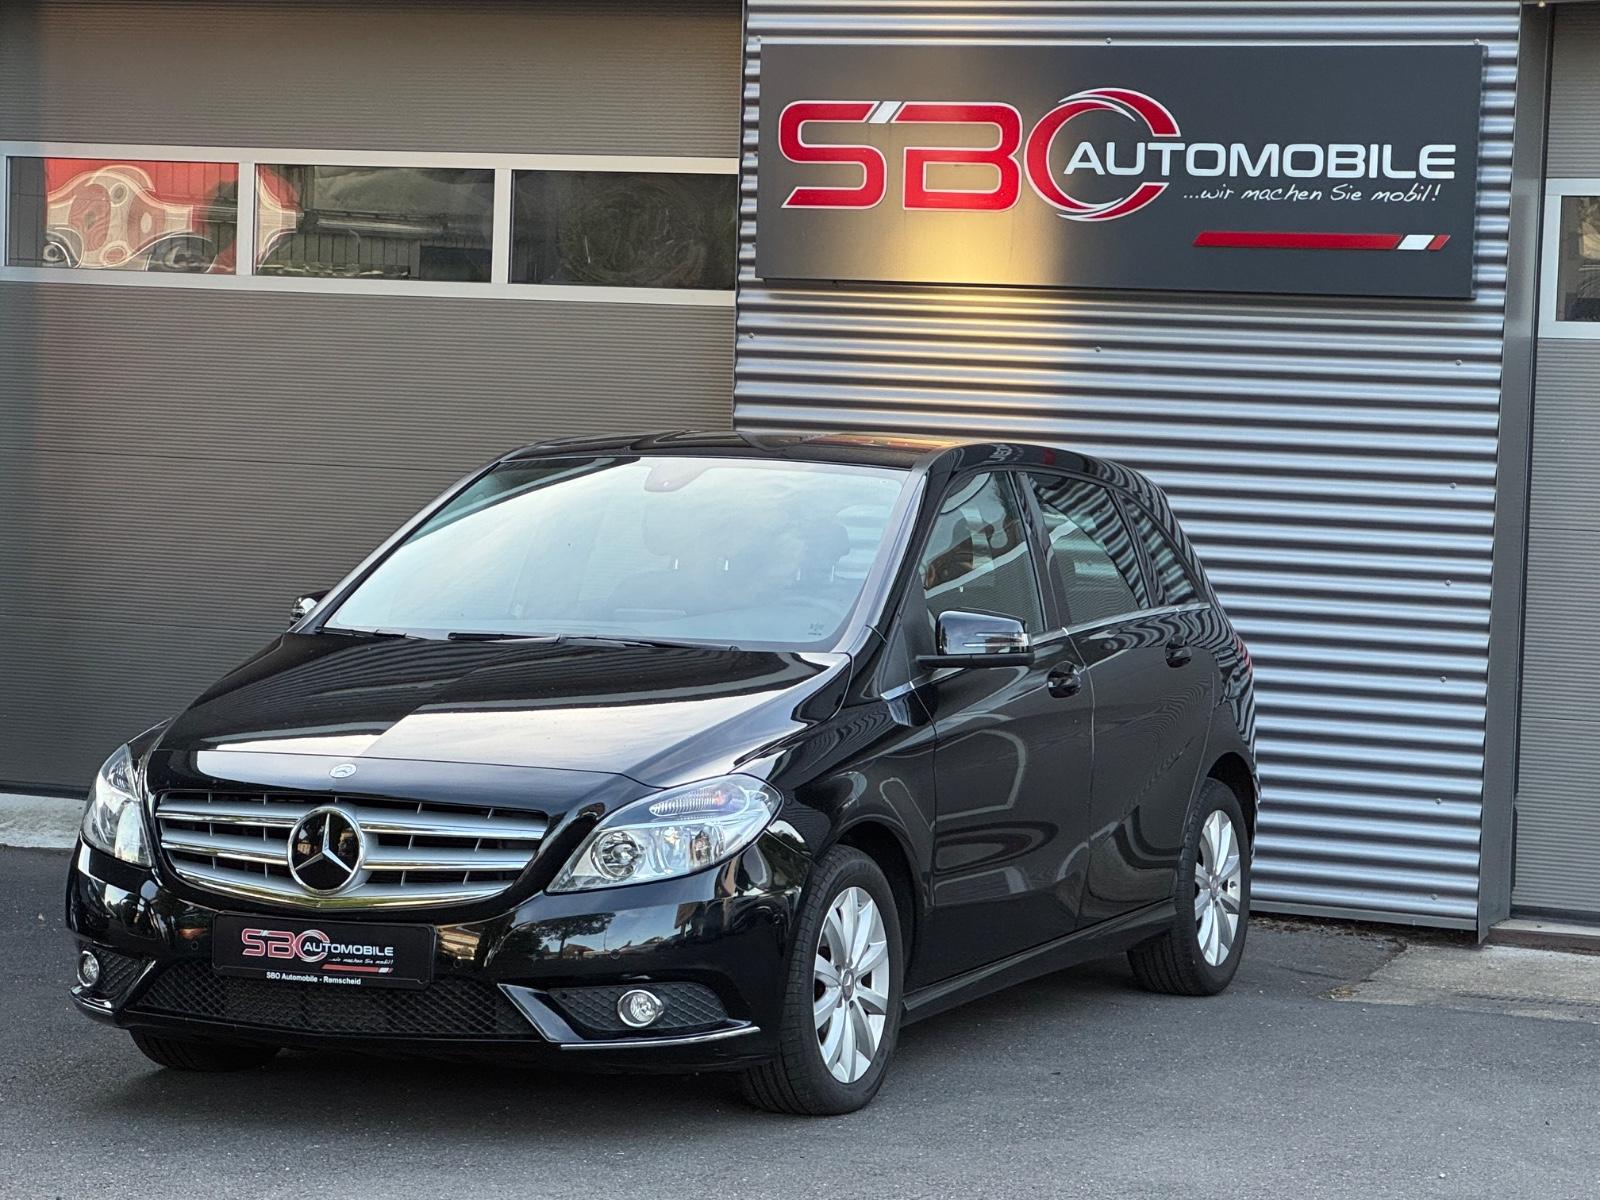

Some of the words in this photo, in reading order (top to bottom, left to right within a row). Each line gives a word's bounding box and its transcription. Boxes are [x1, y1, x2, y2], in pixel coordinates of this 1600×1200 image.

[1064, 141, 1457, 181] AUTOMOBILE
[1242, 183, 1323, 202] machen
[1330, 183, 1363, 202] Sie
[1370, 182, 1442, 203] mobil!
[303, 941, 394, 957] AUTOMOBILE
[266, 971, 281, 980] SBO
[281, 973, 318, 983] Automobile
